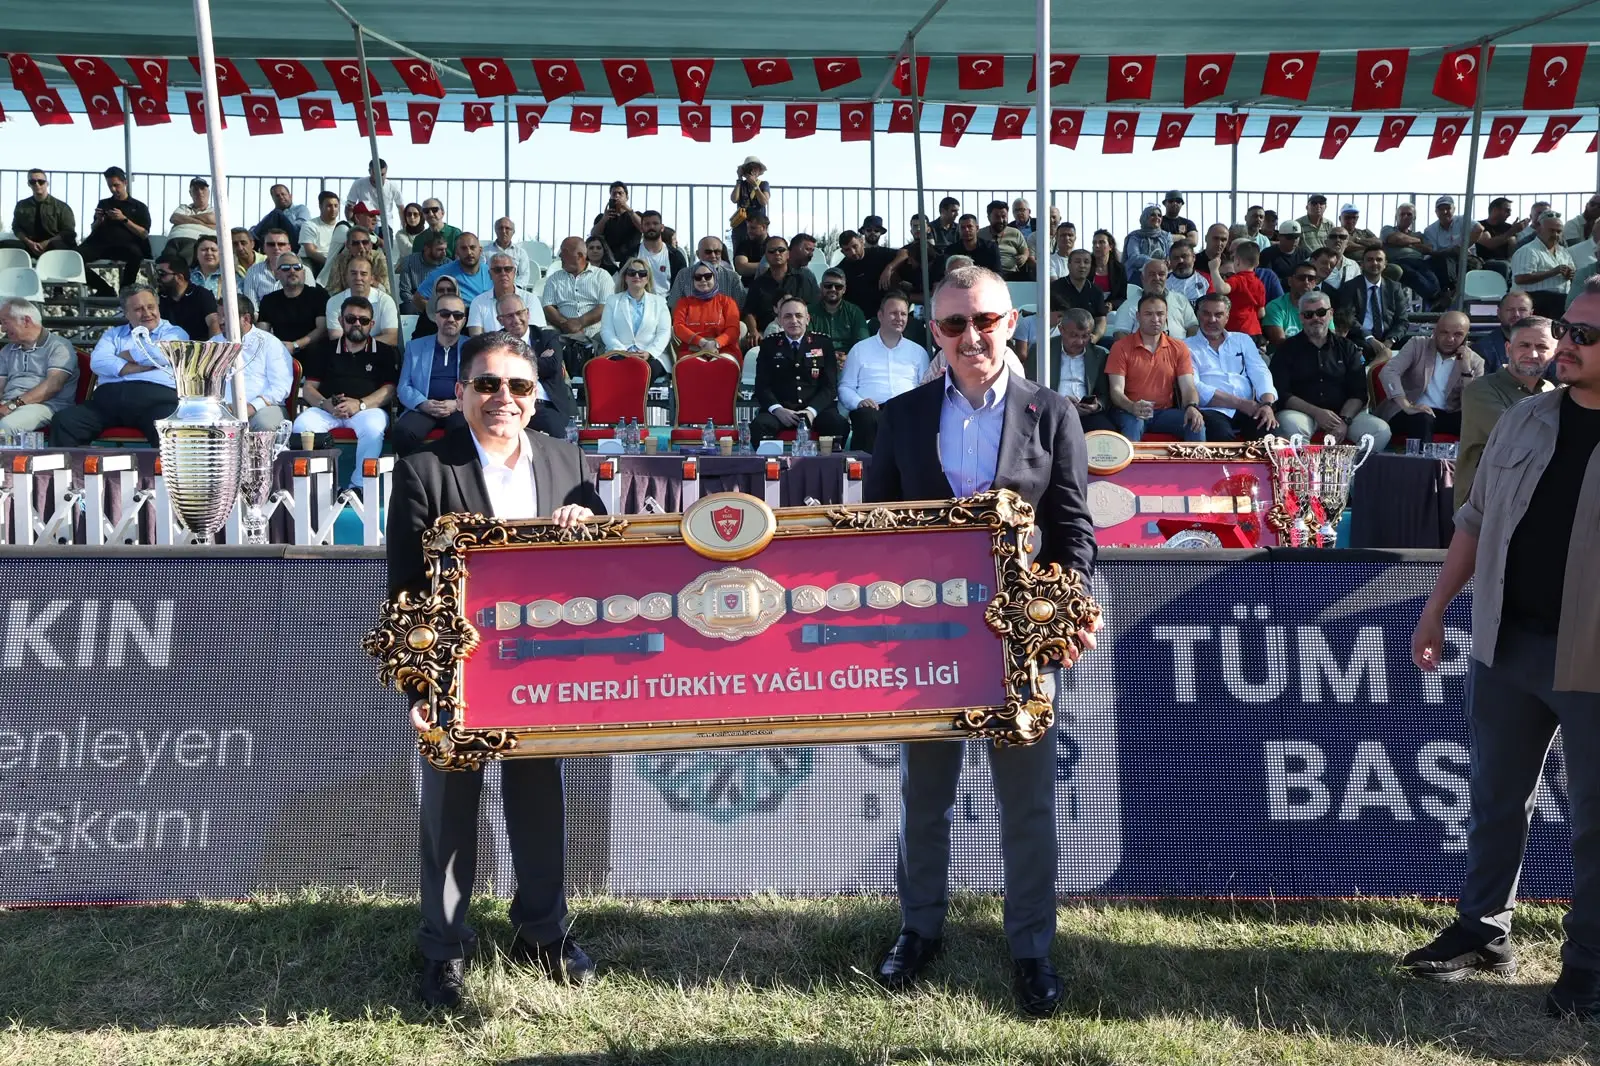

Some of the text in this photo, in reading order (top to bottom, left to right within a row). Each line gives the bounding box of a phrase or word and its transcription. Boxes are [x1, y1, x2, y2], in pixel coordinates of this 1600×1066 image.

[511, 660, 960, 705] CW ENERJİ TÜRKİYE YAĞLI GÜREŞ LİGİ
[1153, 605, 1390, 703] TÜM
